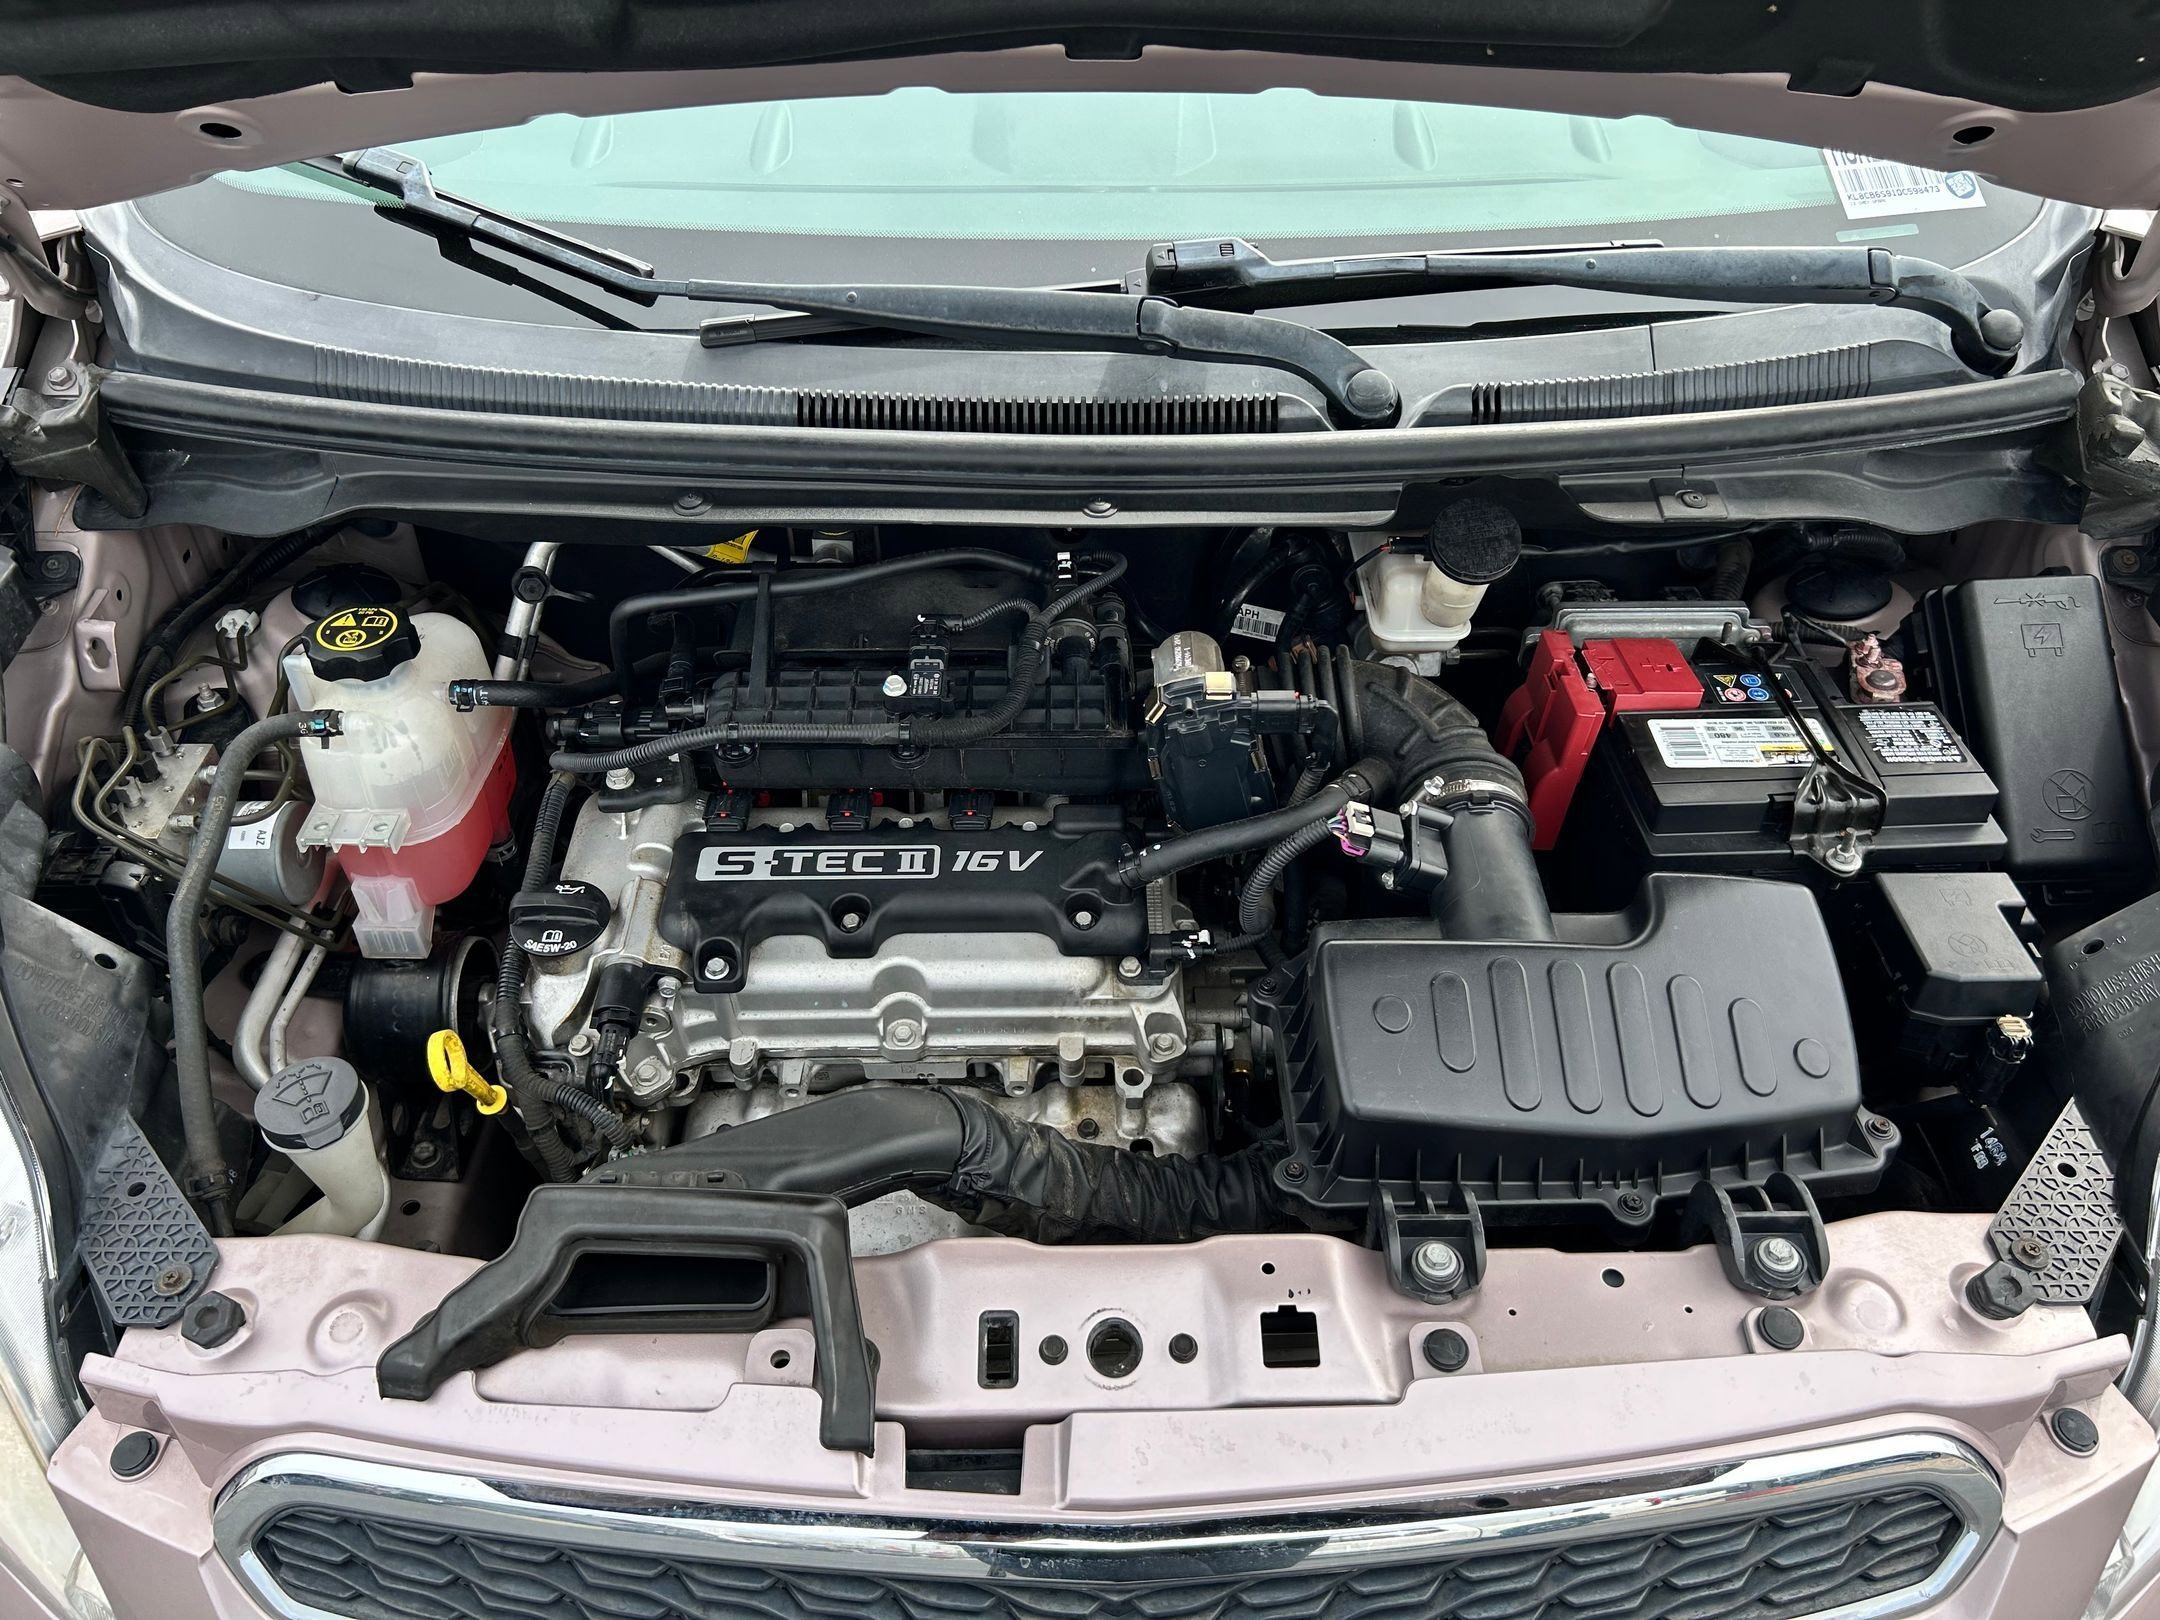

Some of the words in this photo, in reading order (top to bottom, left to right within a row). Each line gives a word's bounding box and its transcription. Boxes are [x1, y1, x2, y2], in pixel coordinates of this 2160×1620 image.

[714, 850, 886, 876] S-TEC
[951, 849, 1045, 873] 16V
[523, 939, 578, 953] SAE5W-20
[2098, 994, 2135, 1023] HOOD
